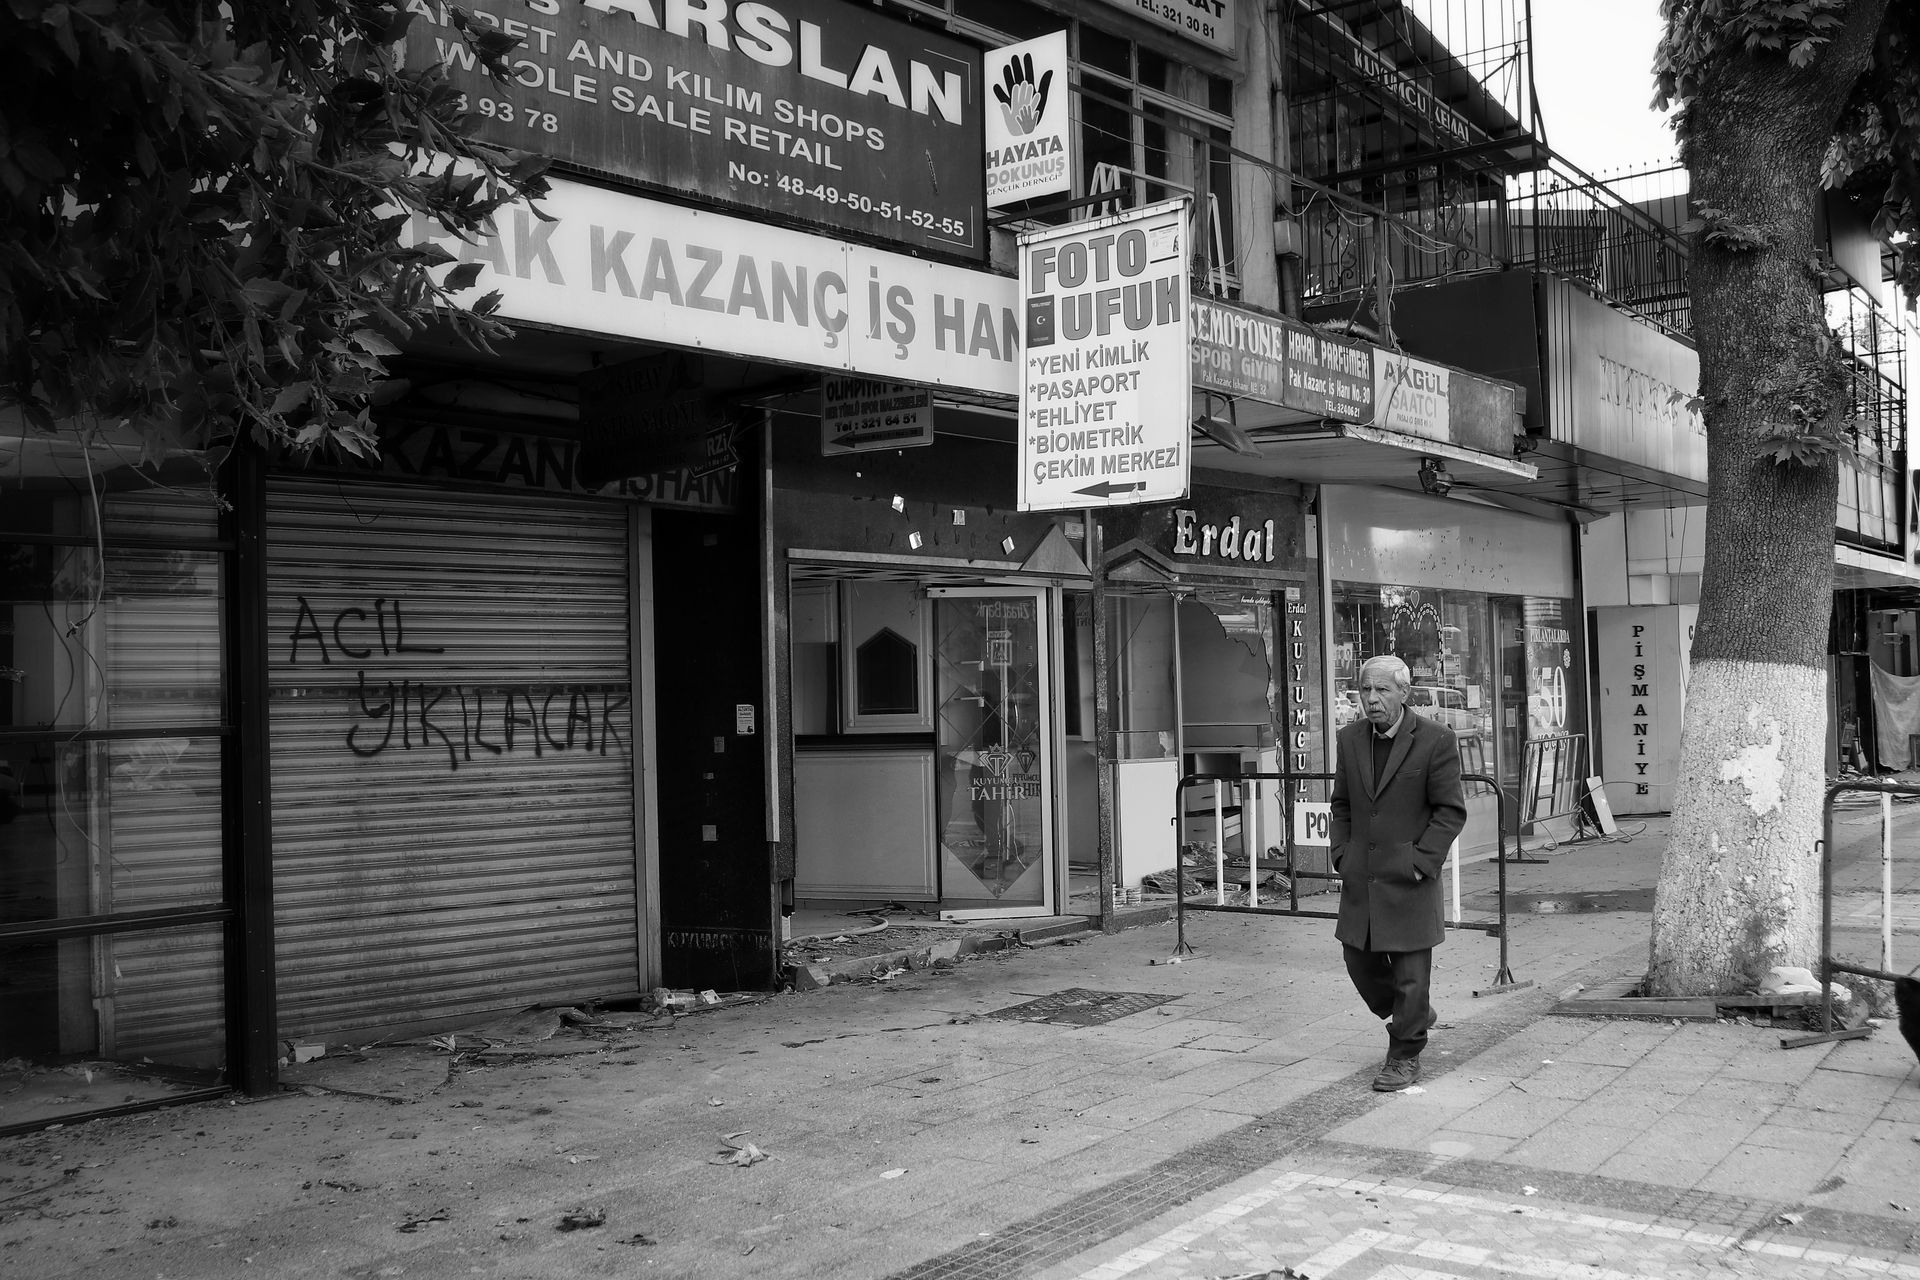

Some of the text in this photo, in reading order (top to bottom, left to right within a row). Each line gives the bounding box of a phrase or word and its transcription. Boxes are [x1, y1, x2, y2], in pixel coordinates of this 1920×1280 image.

[1163, 5, 1182, 24] 321
[1186, 15, 1199, 32] 30
[1203, 23, 1215, 39] 81
[566, 37, 653, 83] AND
[666, 65, 762, 116] KILIM
[773, 99, 885, 152] SHOPS
[479, 97, 514, 122] 93
[524, 107, 558, 133] 78
[611, 86, 711, 135] SALE
[724, 116, 843, 171] RETAIL
[986, 134, 1064, 169] HAYATA
[987, 156, 1065, 188] DOKUNUŞ
[728, 160, 965, 237] No: 48-49-50-51-52-55
[1031, 228, 1148, 295] FOTO
[589, 223, 848, 349] KAZANÇ
[868, 264, 917, 361] İŞ
[1085, 340, 1150, 372] KİMLİK
[1191, 344, 1232, 372] SPOR
[1288, 330, 1318, 366] HAYAL
[1289, 367, 1302, 389] Pak
[1384, 360, 1447, 398] AKGÜL
[861, 416, 881, 429] 321
[885, 414, 900, 426] 64
[1032, 441, 1181, 485] ÇEKİM MERKEZİ
[1173, 507, 1275, 563] Erdal
[1287, 602, 1307, 614] Erdal
[1631, 625, 1650, 796] PİŞMANİYE
